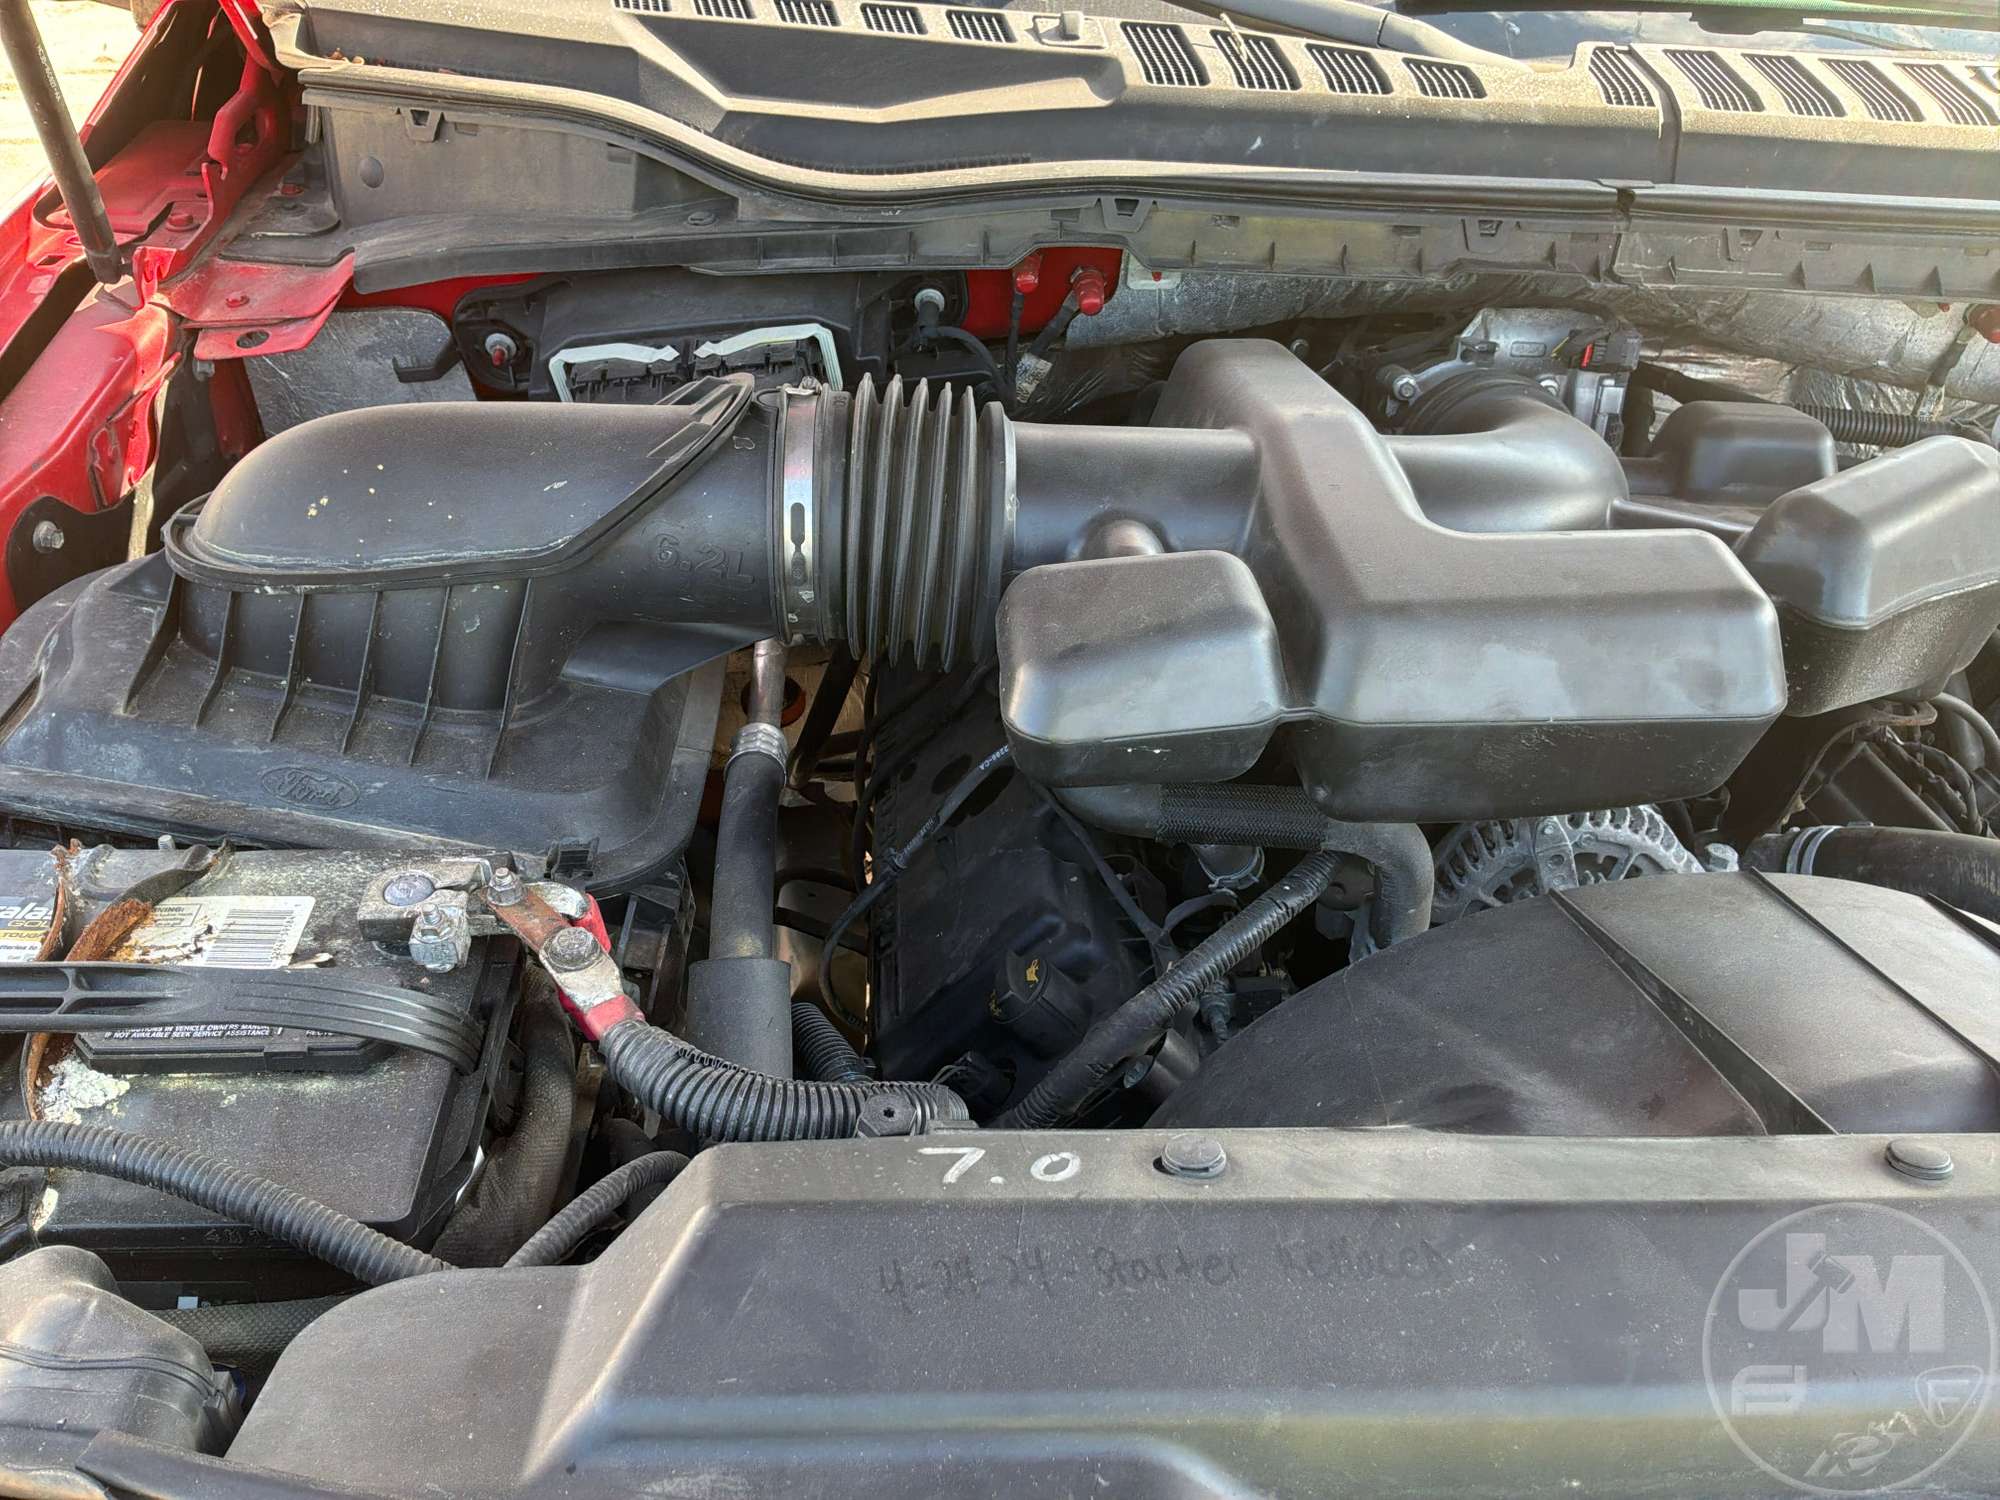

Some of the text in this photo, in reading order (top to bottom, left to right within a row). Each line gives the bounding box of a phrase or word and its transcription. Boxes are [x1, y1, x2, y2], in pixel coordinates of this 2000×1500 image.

[656, 533, 755, 584] 6.2L
[8, 920, 50, 928] GOL
[113, 1031, 130, 1039] NOT
[130, 1031, 170, 1039] AVAILABLE
[224, 1028, 270, 1037] ASSISTANCE
[917, 1146, 1082, 1184] 7.0
